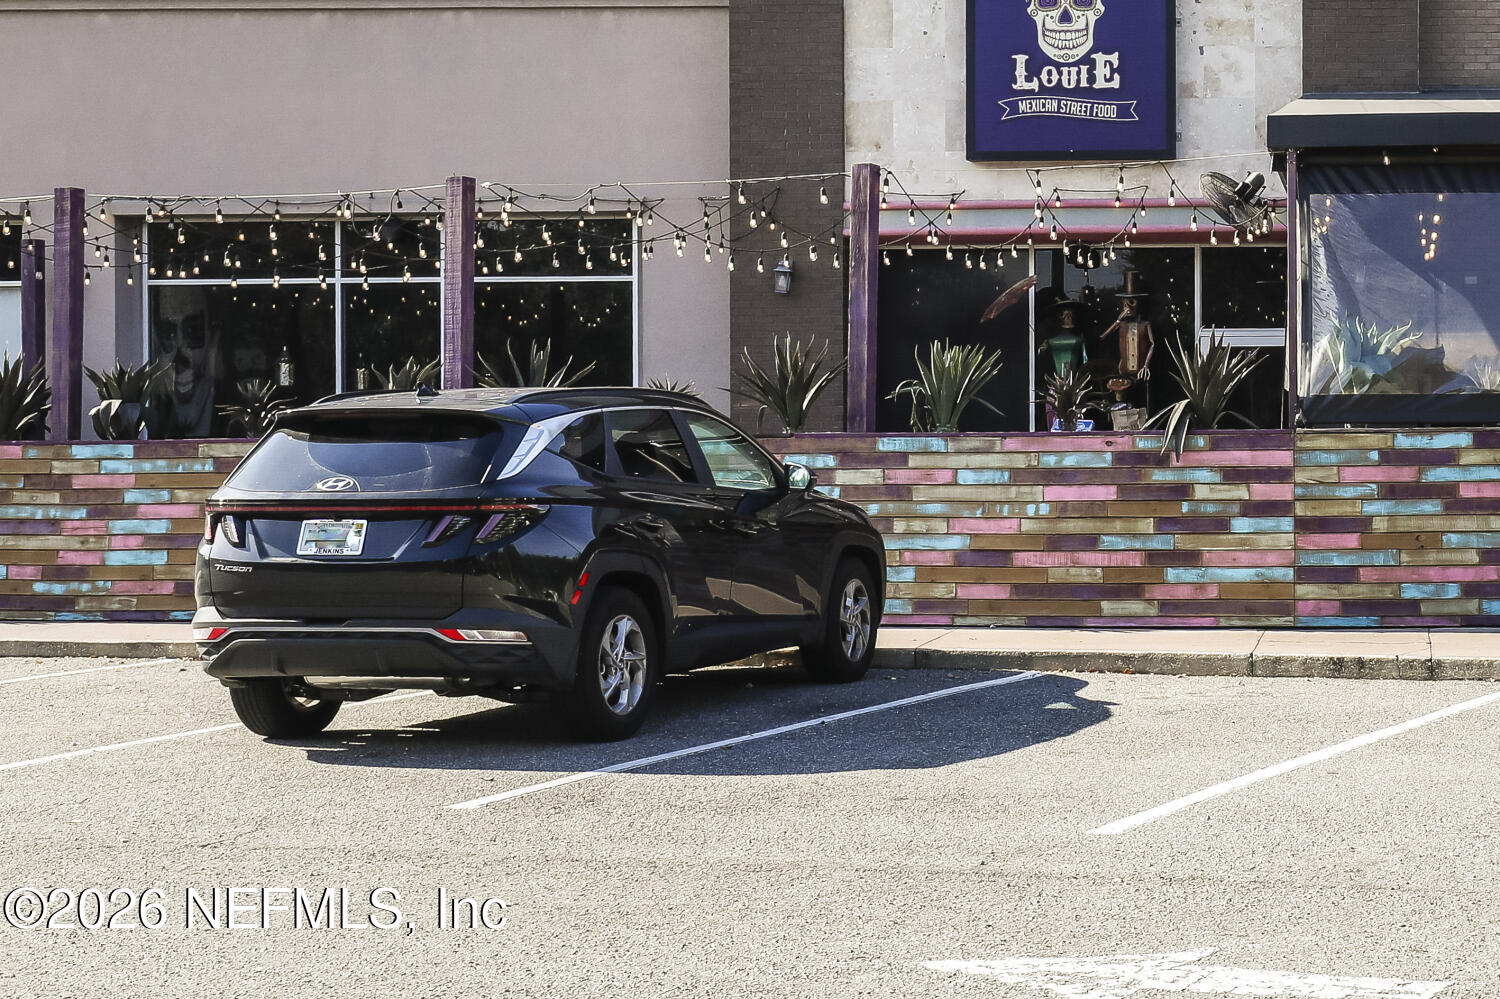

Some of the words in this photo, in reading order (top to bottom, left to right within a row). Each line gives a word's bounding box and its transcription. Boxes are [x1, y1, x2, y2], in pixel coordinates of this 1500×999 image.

[1011, 51, 1120, 93] LOUIE
[1018, 98, 1058, 114] MEXICAN
[1060, 101, 1092, 117] STREET
[1093, 103, 1117, 118] FOOD
